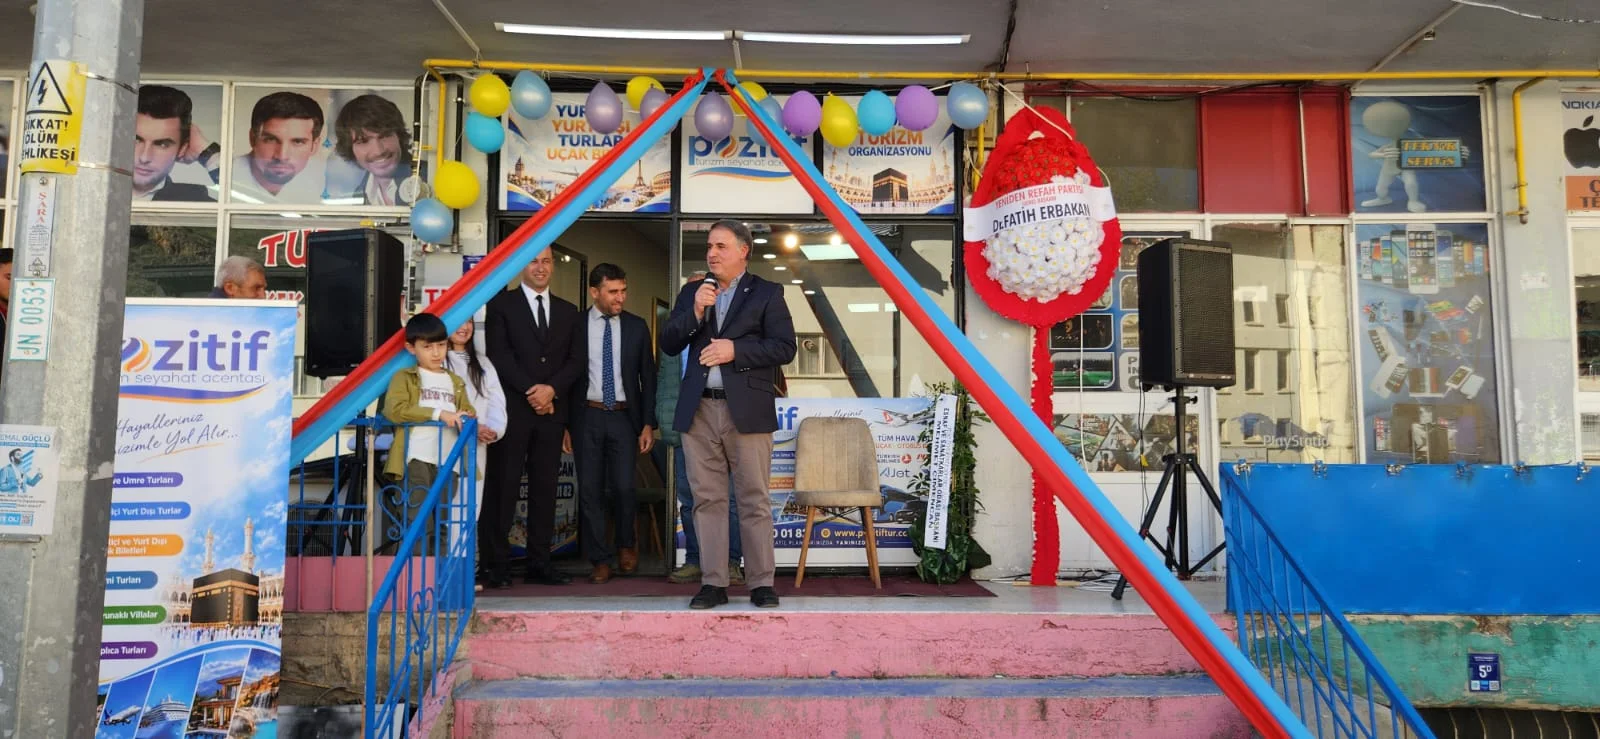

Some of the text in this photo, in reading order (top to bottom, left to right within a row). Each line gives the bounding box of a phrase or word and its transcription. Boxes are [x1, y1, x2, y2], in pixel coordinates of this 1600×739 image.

[556, 105, 587, 117] YUR
[547, 149, 588, 161] UÇAK
[848, 145, 932, 156] ORGANİZASYONU
[1028, 186, 1055, 198] REFAH
[1040, 202, 1090, 219] ERBAKAN
[19, 287, 46, 325] 0053
[136, 372, 196, 385] seyahat
[202, 373, 264, 384] acentası
[117, 435, 160, 454] izimle
[165, 429, 196, 455] Yol
[158, 507, 182, 515] Turlar
[781, 529, 793, 538] 01
[130, 610, 158, 618] Villalar
[101, 646, 147, 656] plıca Turları
